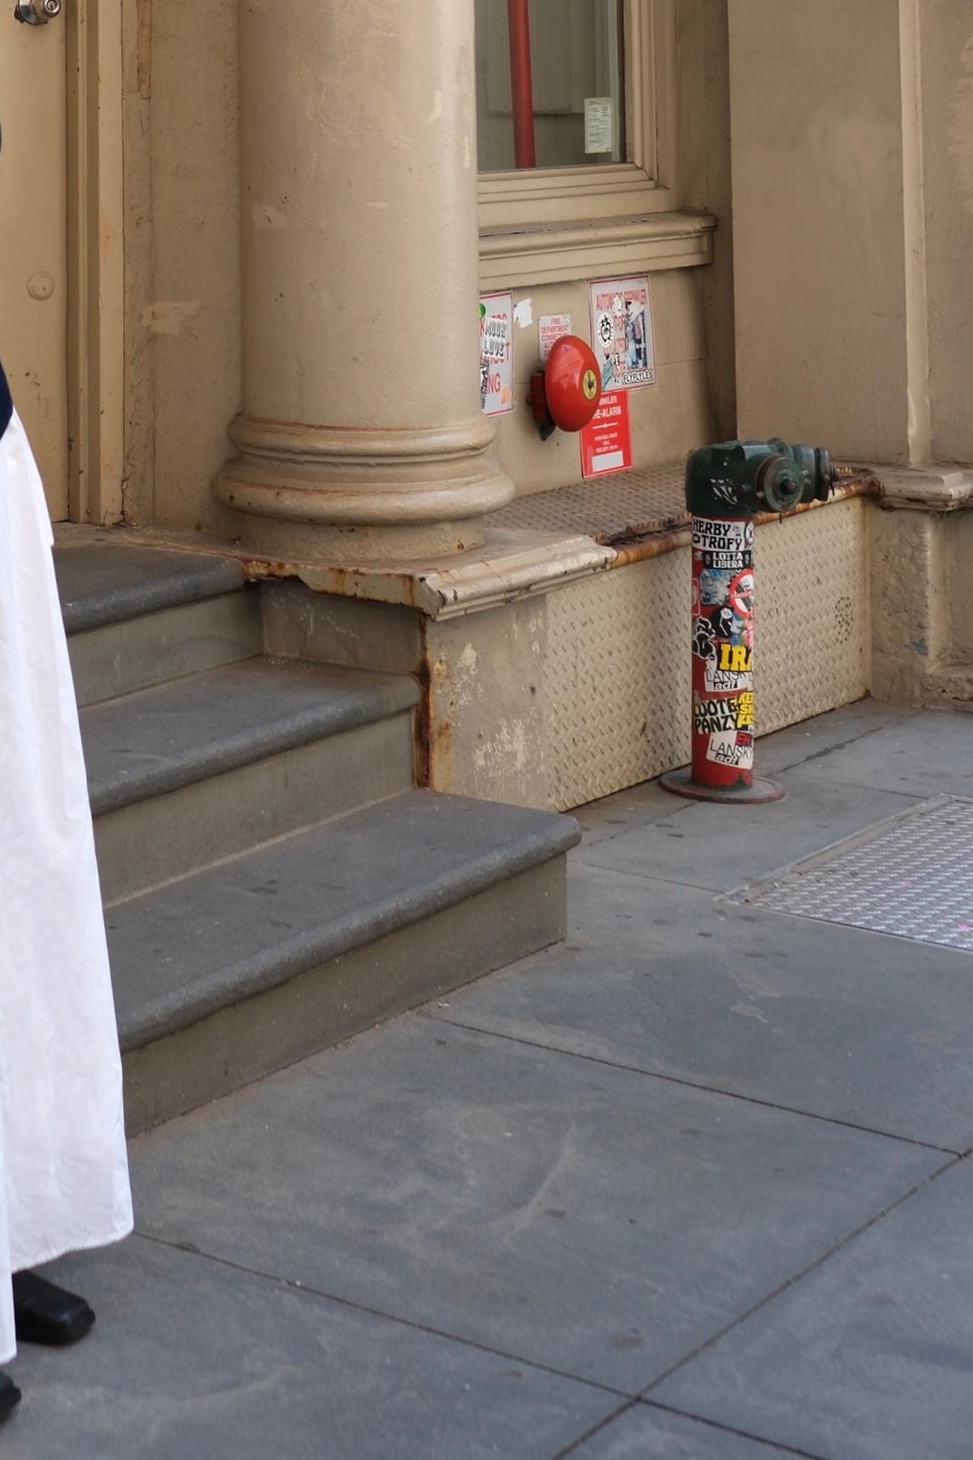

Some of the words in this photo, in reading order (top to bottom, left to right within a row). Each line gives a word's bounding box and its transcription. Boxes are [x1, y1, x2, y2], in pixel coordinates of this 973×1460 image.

[693, 519, 731, 537] HERBY
[712, 552, 743, 560] LOTTA
[712, 560, 743, 568] LIBERA
[695, 713, 739, 734] PANZY
